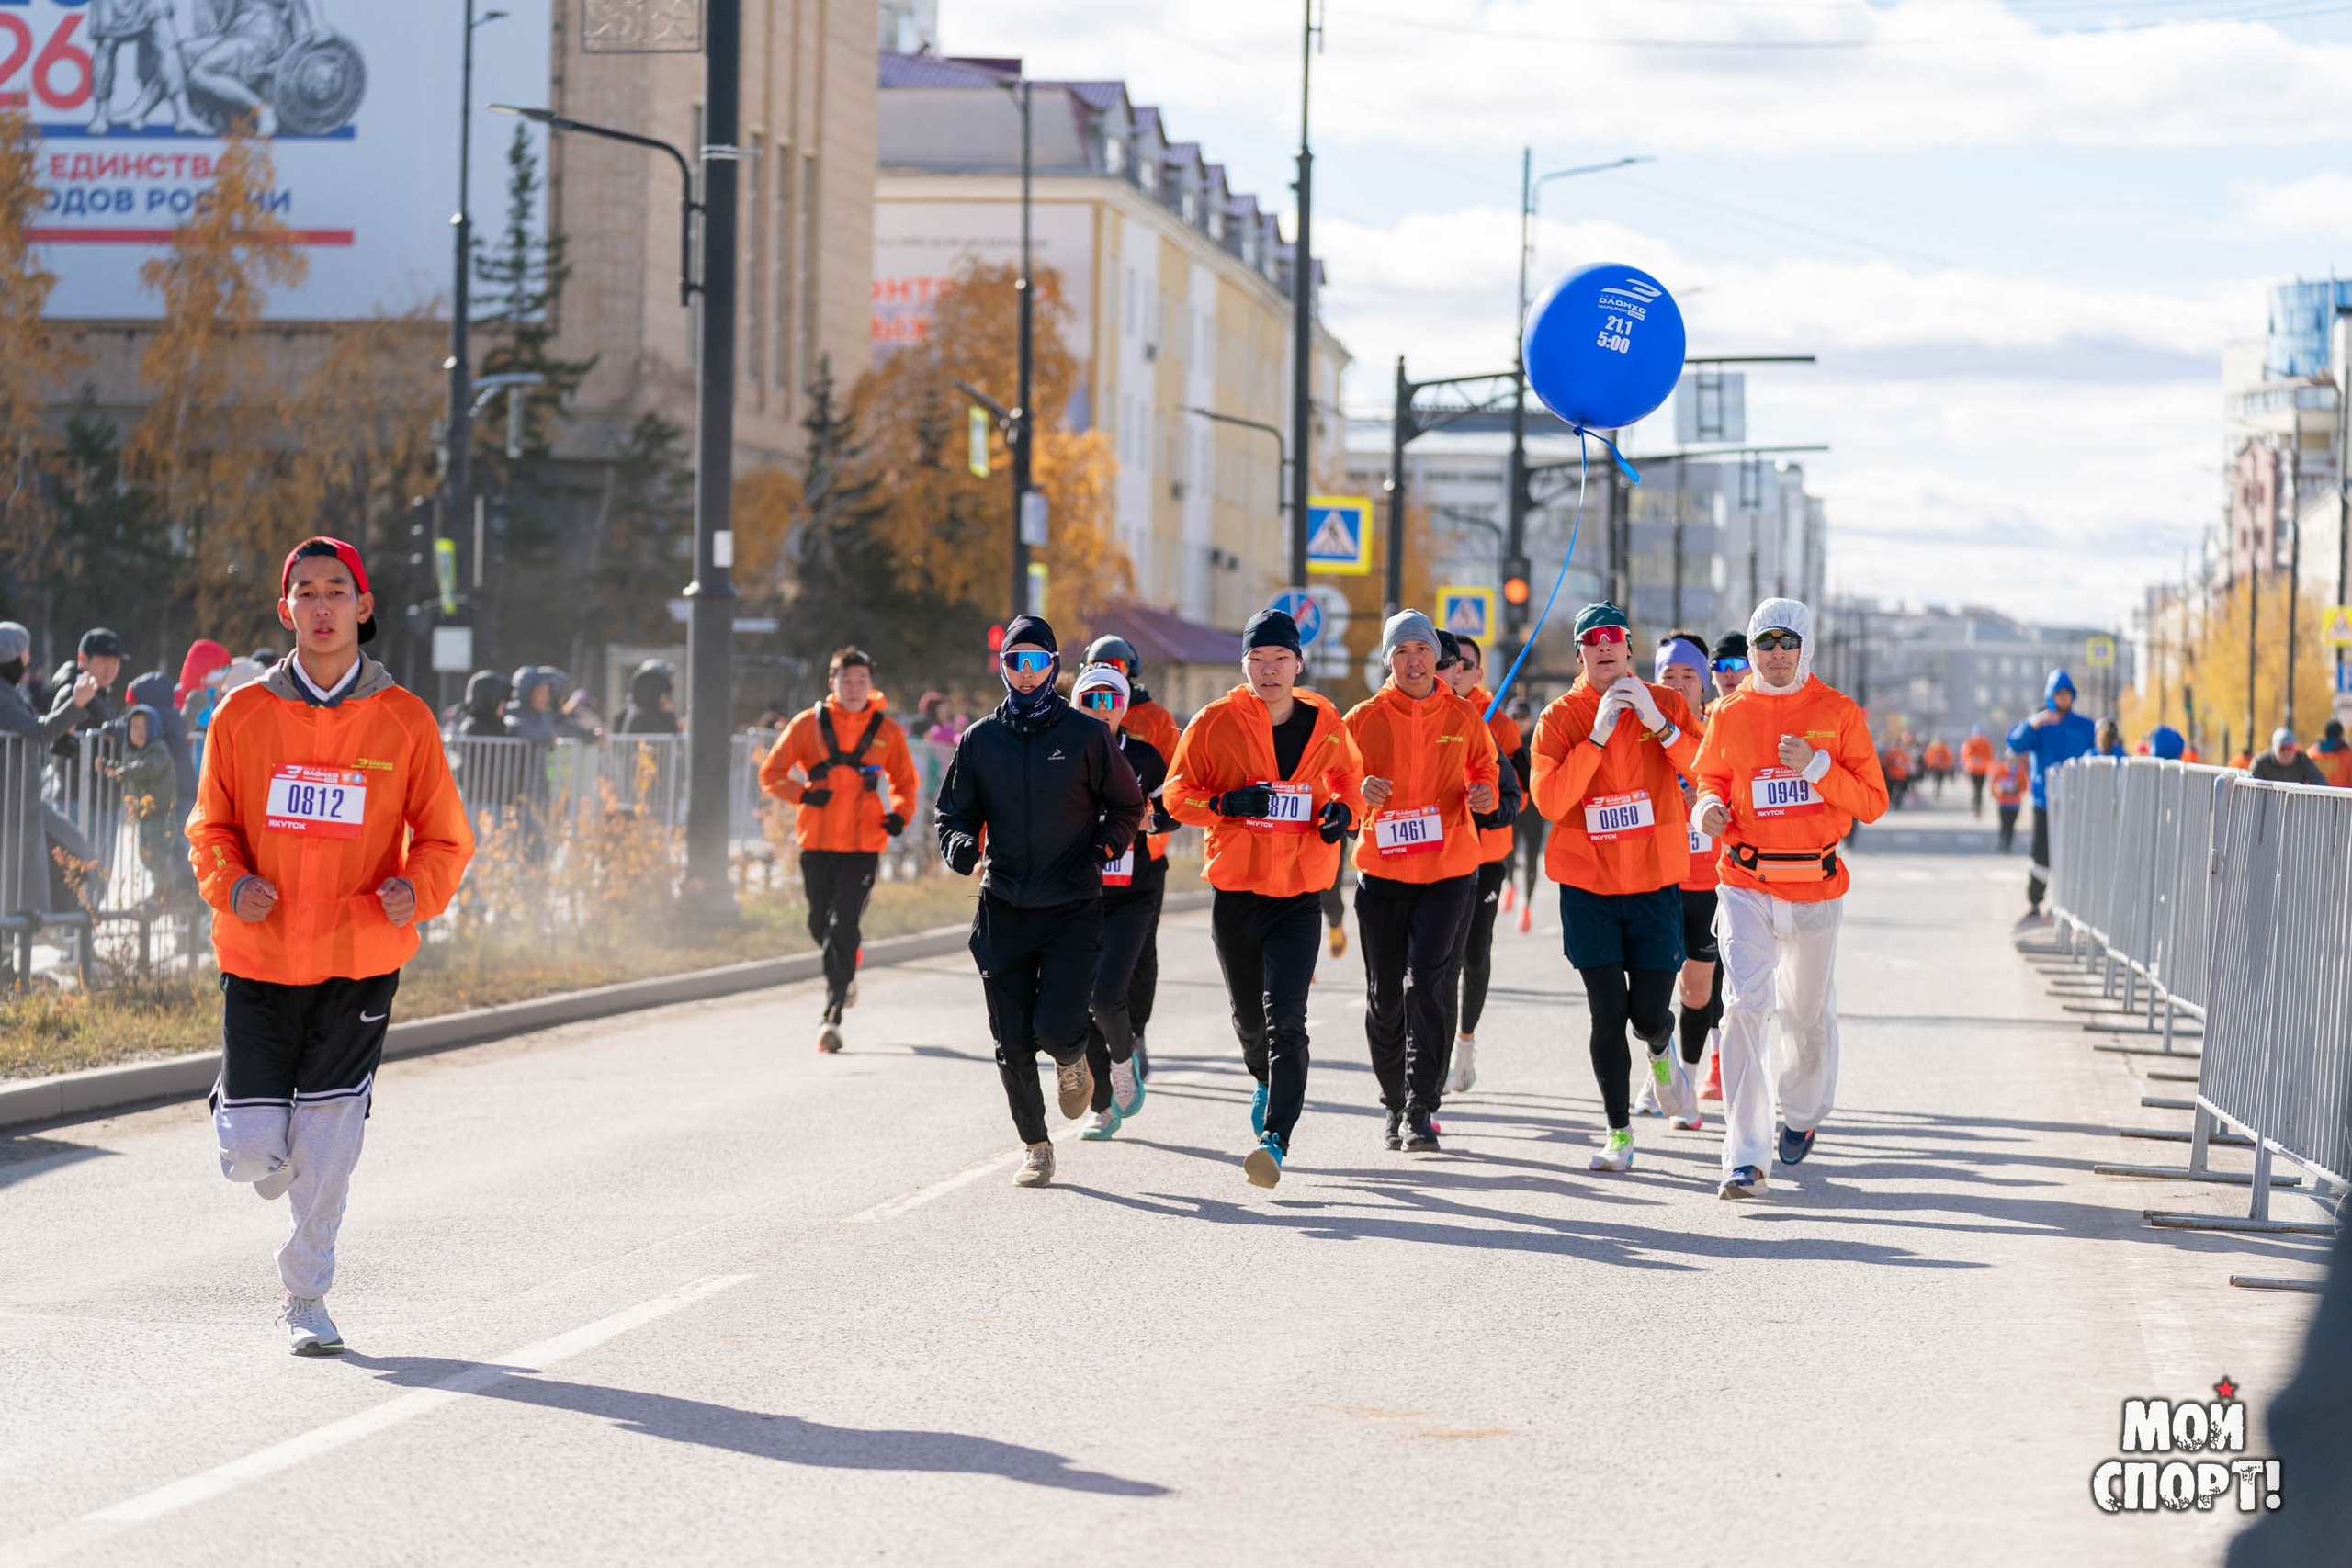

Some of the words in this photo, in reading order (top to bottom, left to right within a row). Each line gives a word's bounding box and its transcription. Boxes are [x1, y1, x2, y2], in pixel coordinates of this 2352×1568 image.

[1604, 315, 1633, 336] 21,1
[1597, 331, 1631, 354] 5:00
[287, 784, 345, 818] 0812
[1767, 779, 1809, 805] 0949
[1270, 795, 1299, 818] 870
[1599, 805, 1639, 830] 0860
[268, 819, 306, 830] ЯКУТСК
[1390, 818, 1427, 844] 1461
